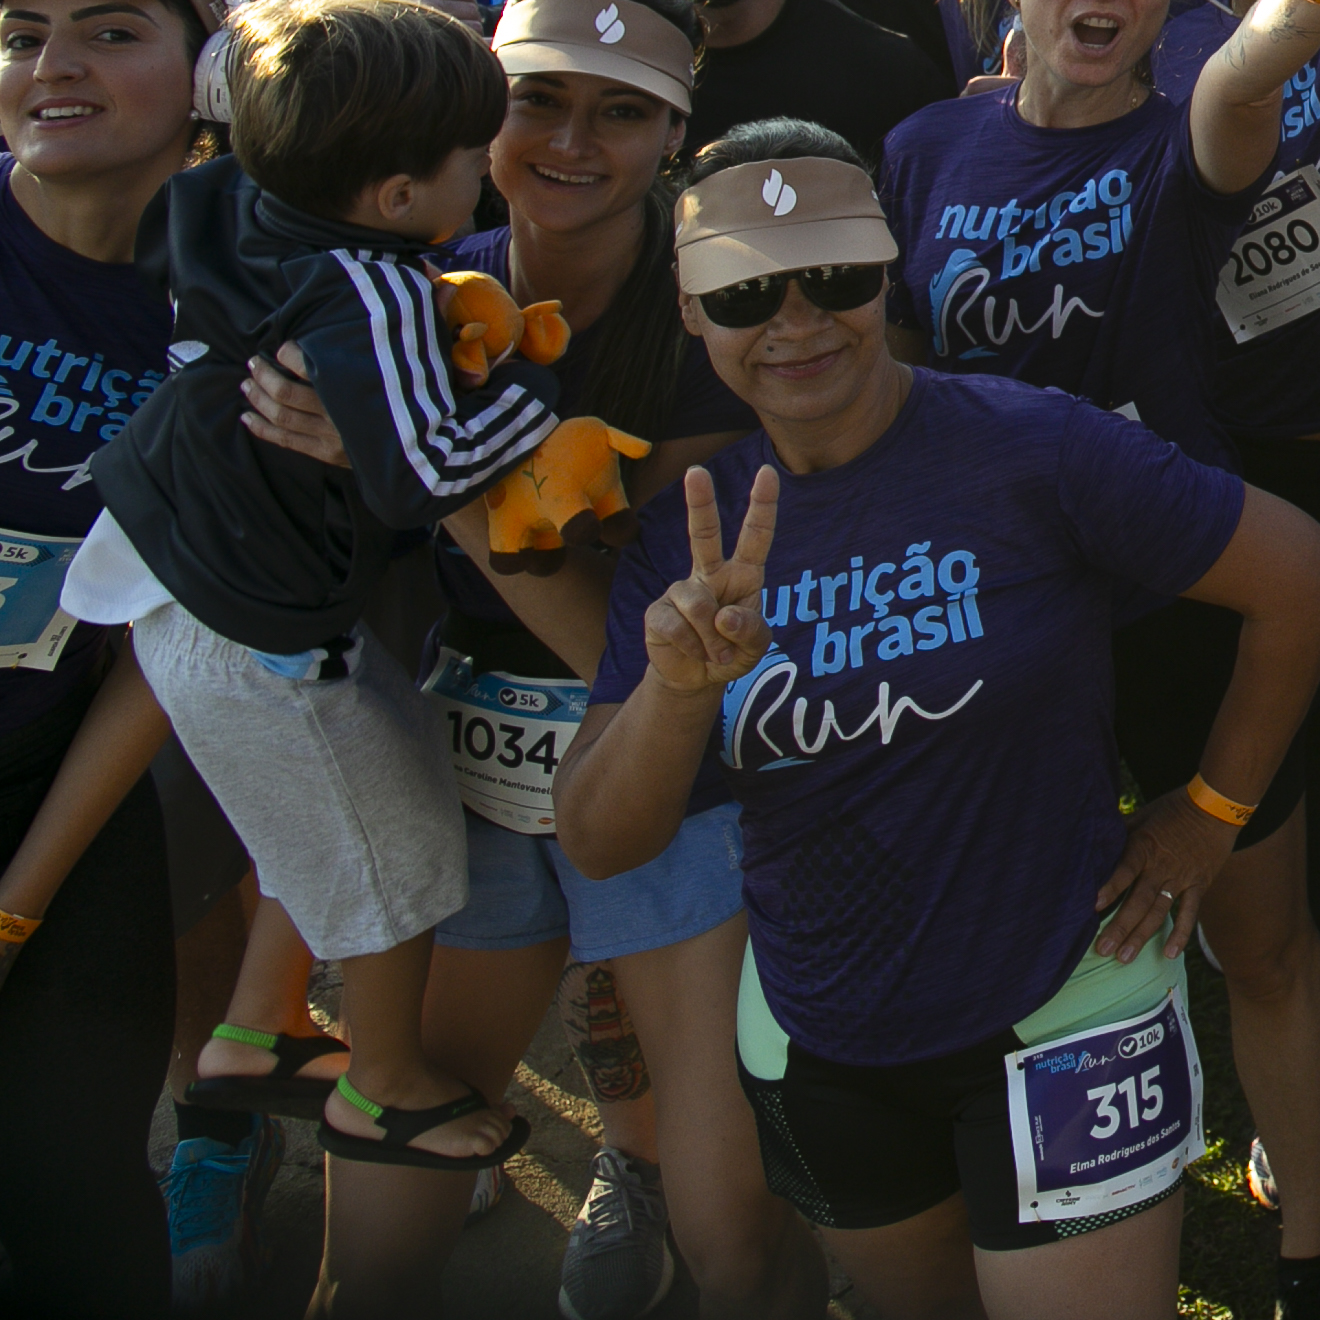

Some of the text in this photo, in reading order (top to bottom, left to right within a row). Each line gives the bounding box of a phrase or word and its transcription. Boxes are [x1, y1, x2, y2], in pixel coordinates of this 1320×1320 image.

[1255, 200, 1279, 218] 10k
[1000, 203, 1134, 280] brasil
[1229, 219, 1320, 287] 2080
[936, 267, 1105, 357] Run
[4, 546, 29, 561] 5k
[761, 540, 981, 628] utrição
[811, 587, 984, 678] brasil
[519, 692, 540, 708] 5k
[733, 661, 984, 770] Run
[447, 710, 559, 775] 1034
[464, 766, 498, 786] Caroline
[498, 776, 553, 796] Mantovanel
[721, 822, 737, 870] DOMYOS
[1035, 1052, 1076, 1071] nutrição
[1074, 1053, 1117, 1074] Run
[1139, 1031, 1161, 1049] 10k
[1050, 1061, 1077, 1074] brasil
[1086, 1064, 1164, 1140] 315
[1069, 1119, 1182, 1174] Elma Rodrigues dos Santos
